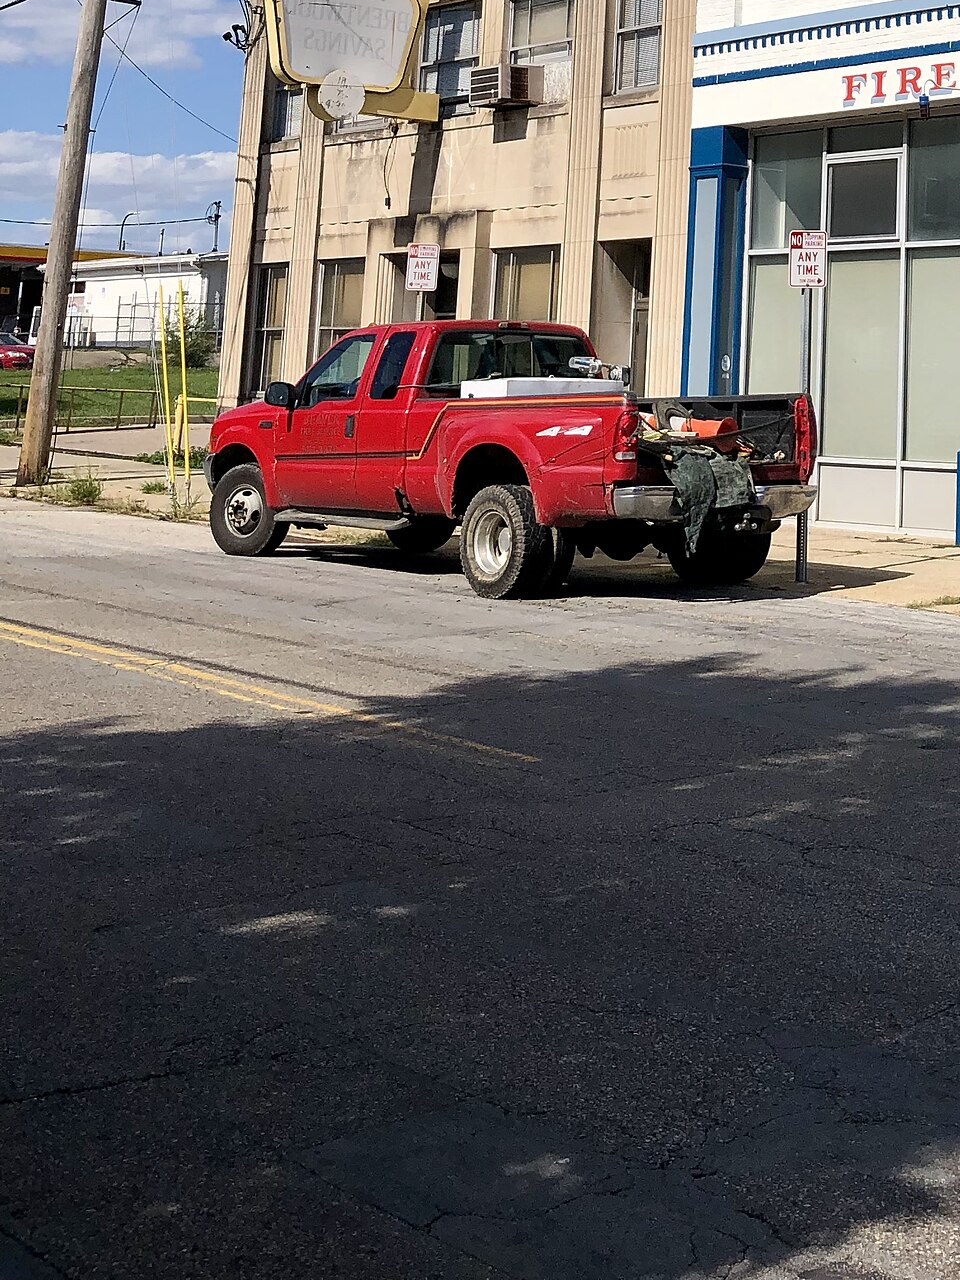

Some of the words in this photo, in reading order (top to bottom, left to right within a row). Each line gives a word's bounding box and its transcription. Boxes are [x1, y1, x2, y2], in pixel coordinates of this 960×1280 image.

[842, 62, 957, 107] FIRE
[792, 235, 802, 246] NO
[410, 246, 418, 256] NO
[798, 252, 818, 262] ANY
[415, 261, 431, 269] ANY
[797, 265, 819, 275] TIME
[413, 272, 431, 280] TIME
